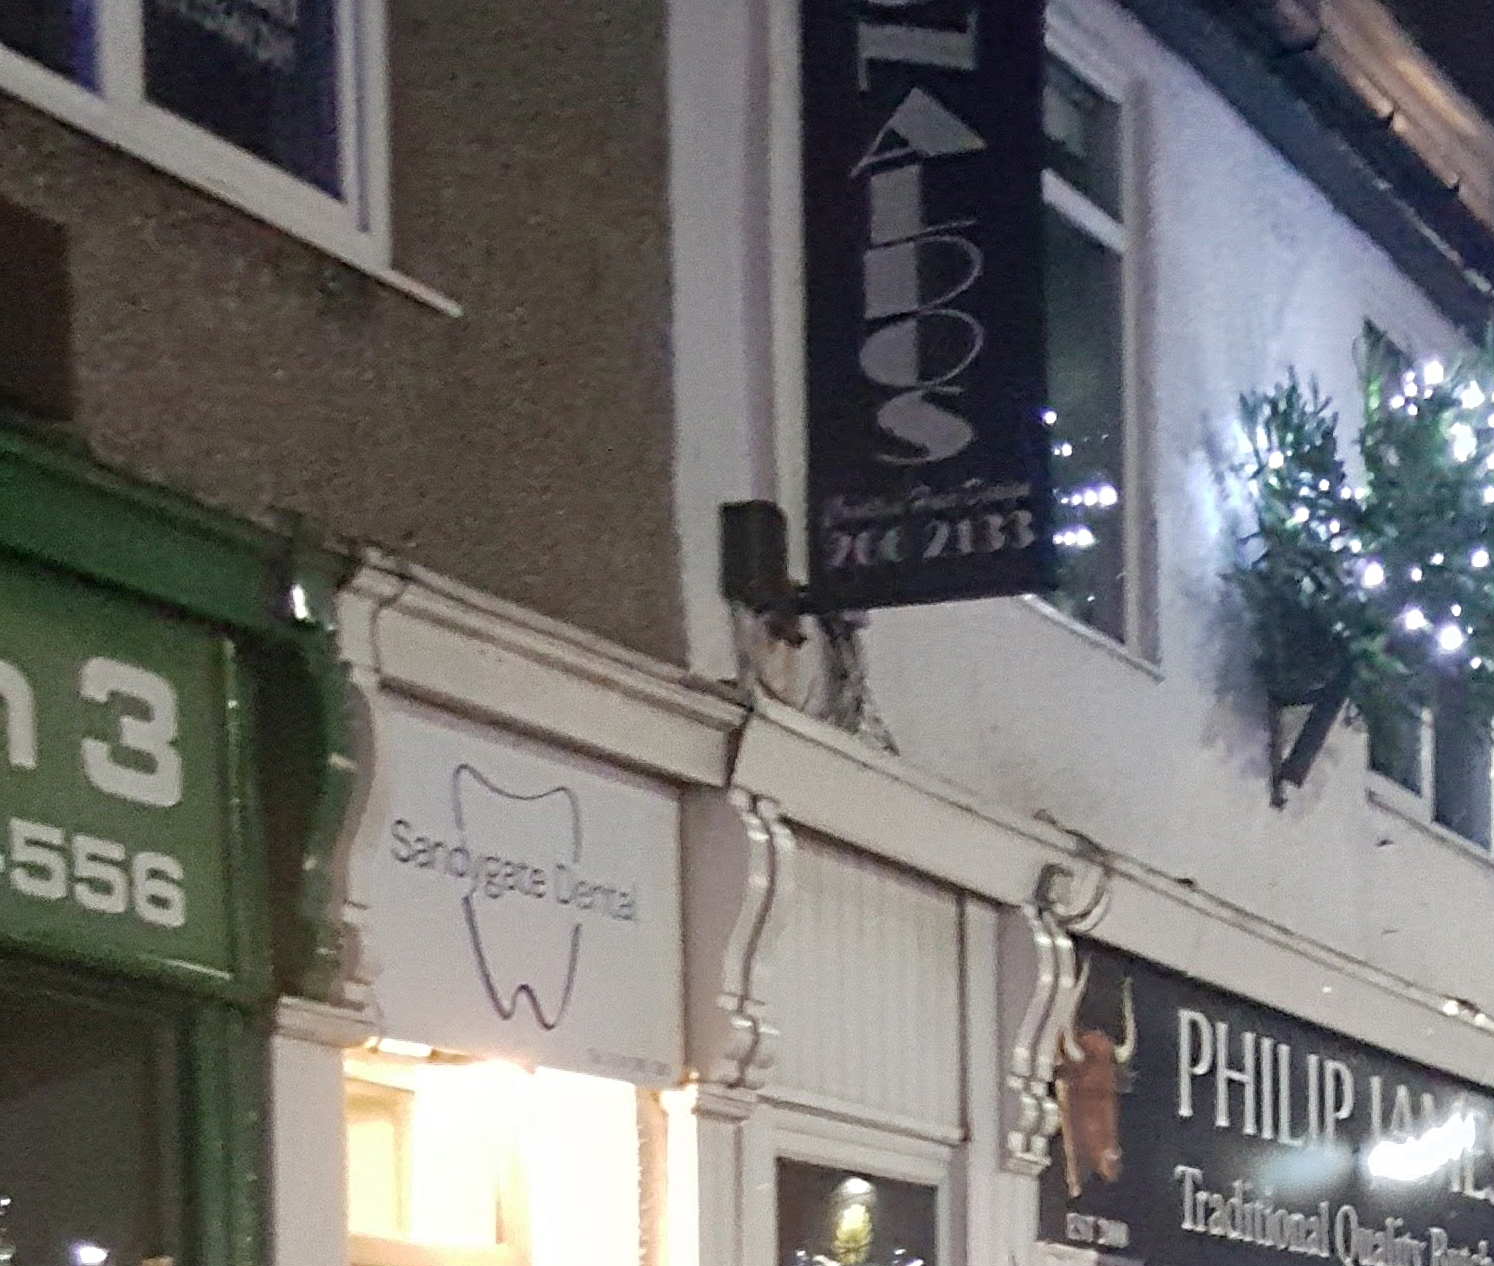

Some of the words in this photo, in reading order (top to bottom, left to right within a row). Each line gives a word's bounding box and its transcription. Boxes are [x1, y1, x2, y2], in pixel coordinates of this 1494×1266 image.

[80, 655, 183, 808] 3
[0, 816, 187, 929] 556
[553, 861, 638, 924] Dental
[1176, 1007, 1355, 1147] PHILIP
[1174, 1164, 1331, 1259] Traditional
